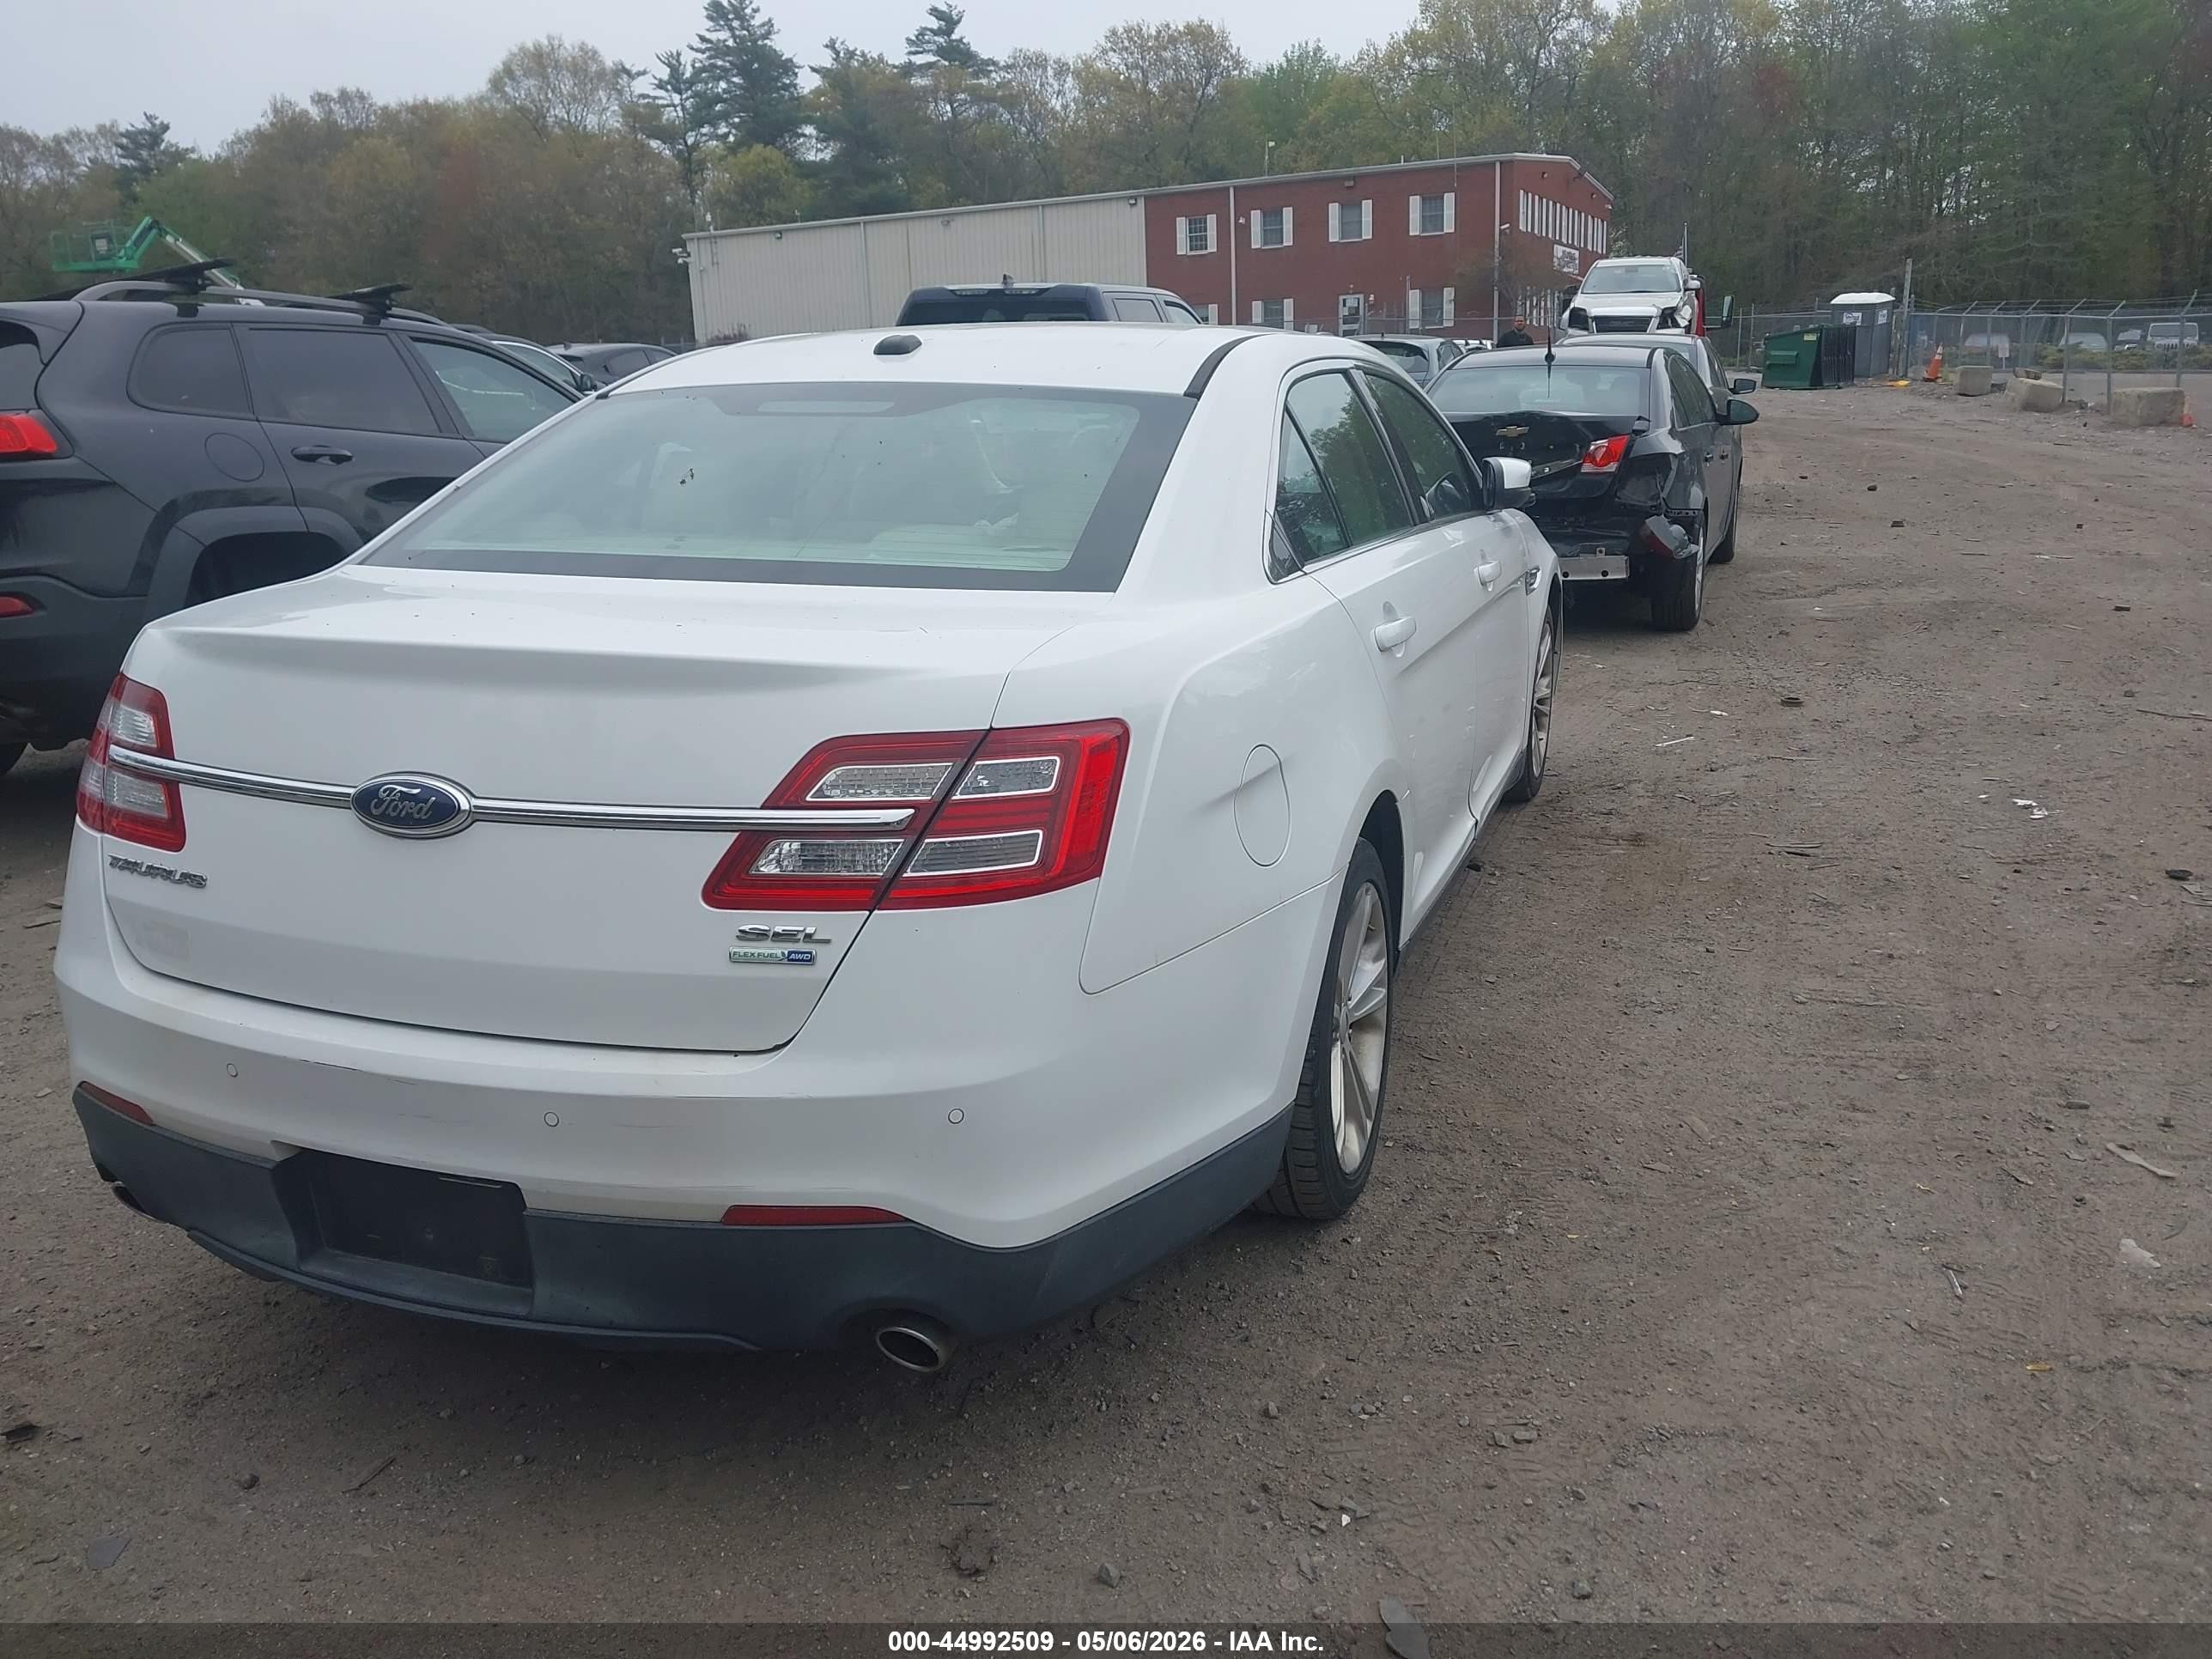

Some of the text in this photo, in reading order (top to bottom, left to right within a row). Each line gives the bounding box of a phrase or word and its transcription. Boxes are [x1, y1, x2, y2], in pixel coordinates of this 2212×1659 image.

[370, 784, 436, 819] Ford
[108, 853, 208, 888] TAURUS
[735, 924, 832, 944] SEL
